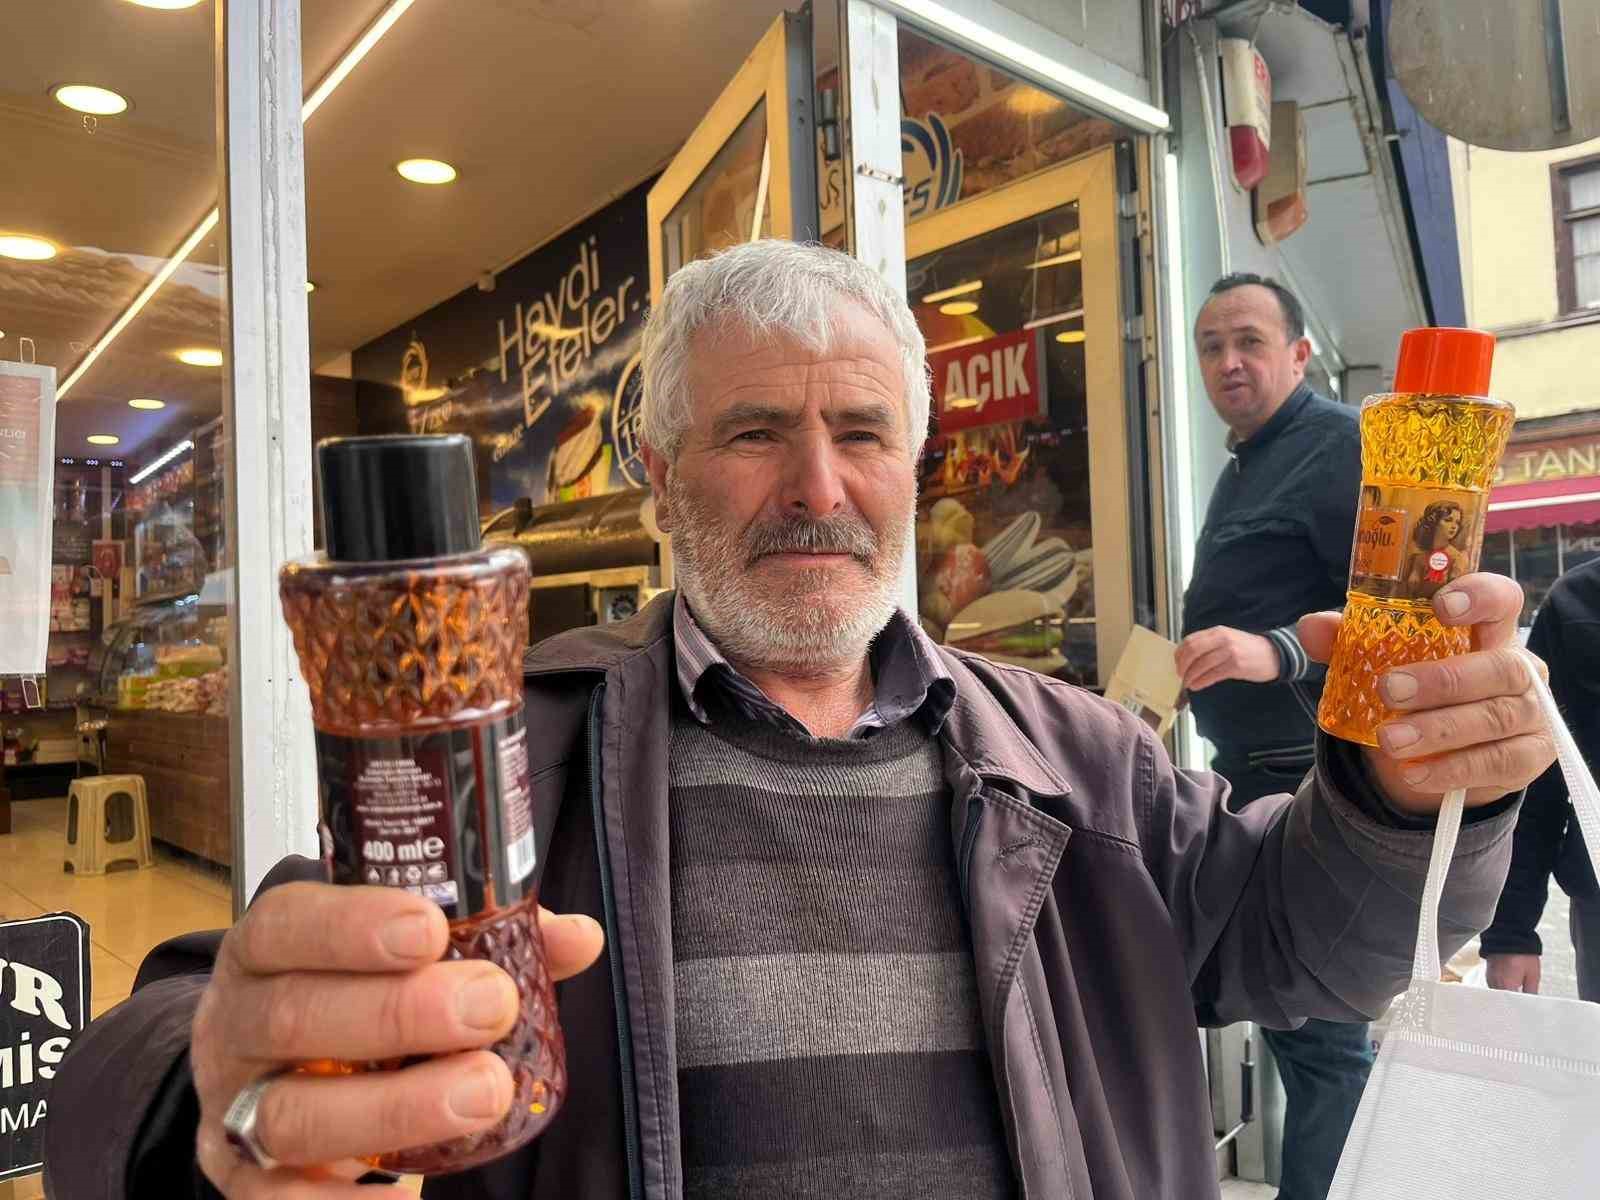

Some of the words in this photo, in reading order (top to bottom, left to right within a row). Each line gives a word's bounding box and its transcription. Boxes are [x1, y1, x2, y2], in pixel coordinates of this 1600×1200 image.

[498, 235, 600, 384] Haydi
[944, 342, 1030, 412] AÇIK
[363, 840, 394, 862] 400
